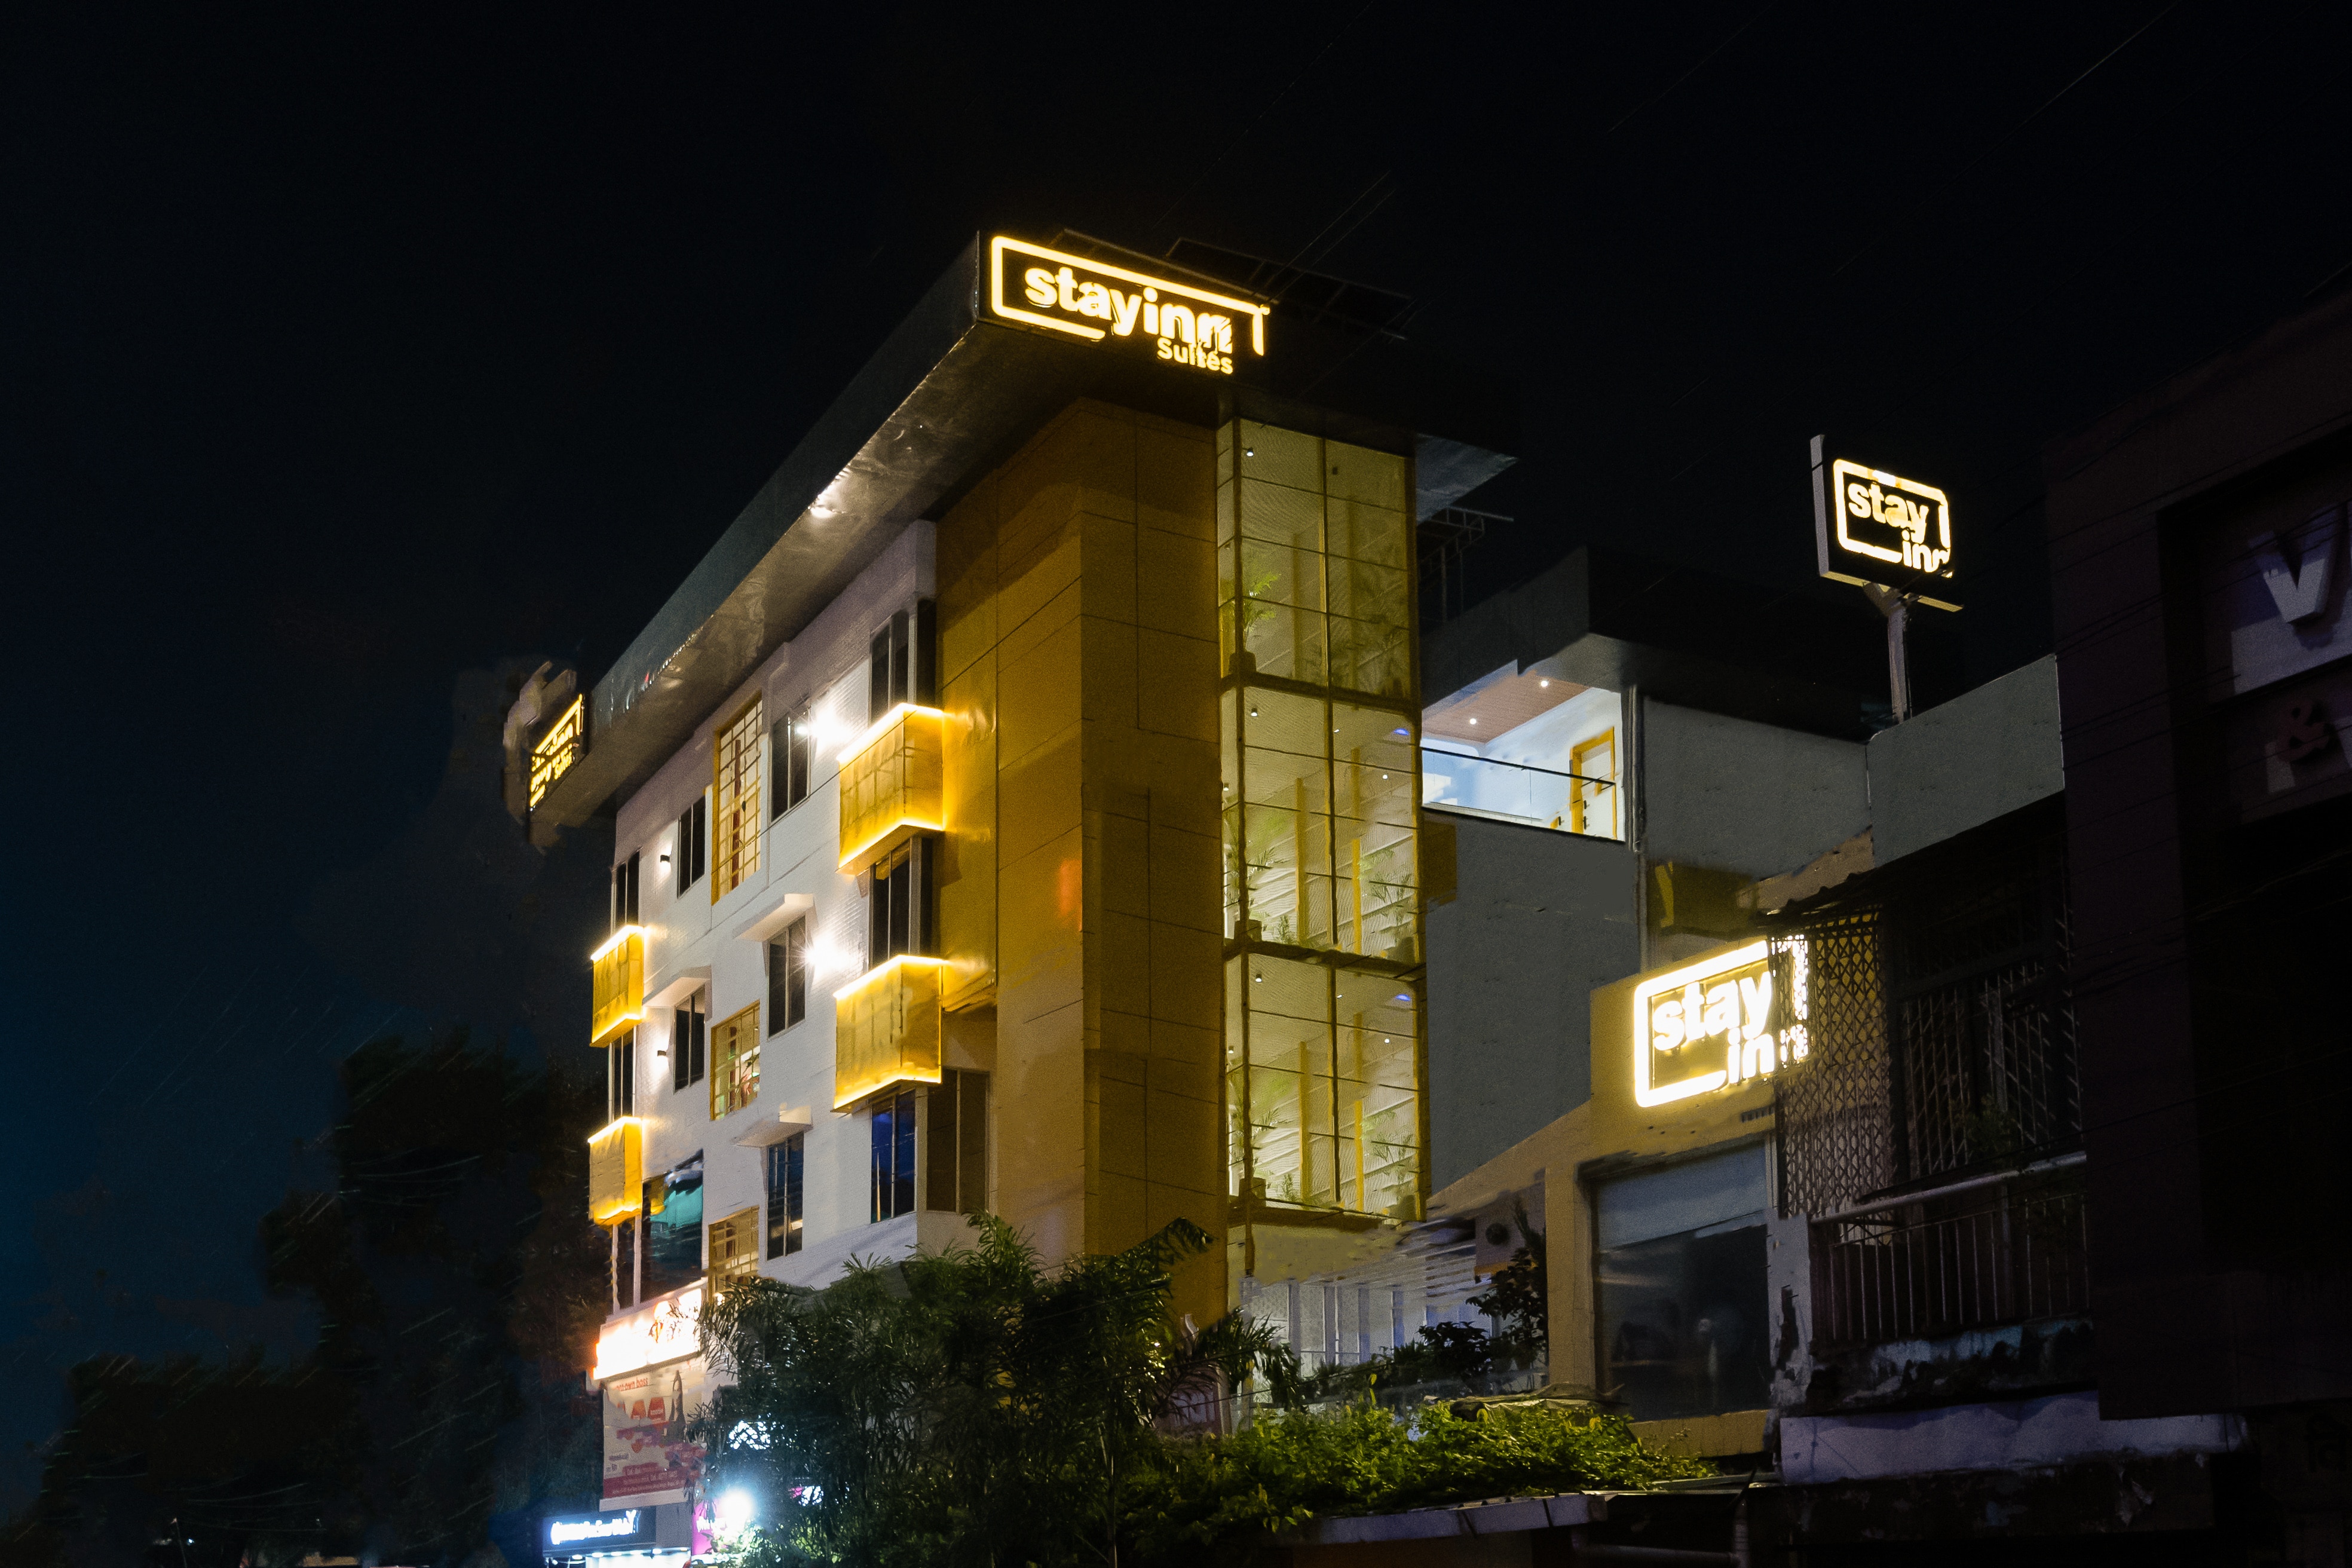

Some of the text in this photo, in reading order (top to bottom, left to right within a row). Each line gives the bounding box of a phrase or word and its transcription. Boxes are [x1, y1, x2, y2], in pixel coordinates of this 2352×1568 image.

[1156, 336, 1233, 375] Suites
[1847, 482, 1930, 544] stay
[1652, 970, 1773, 1052] stay
